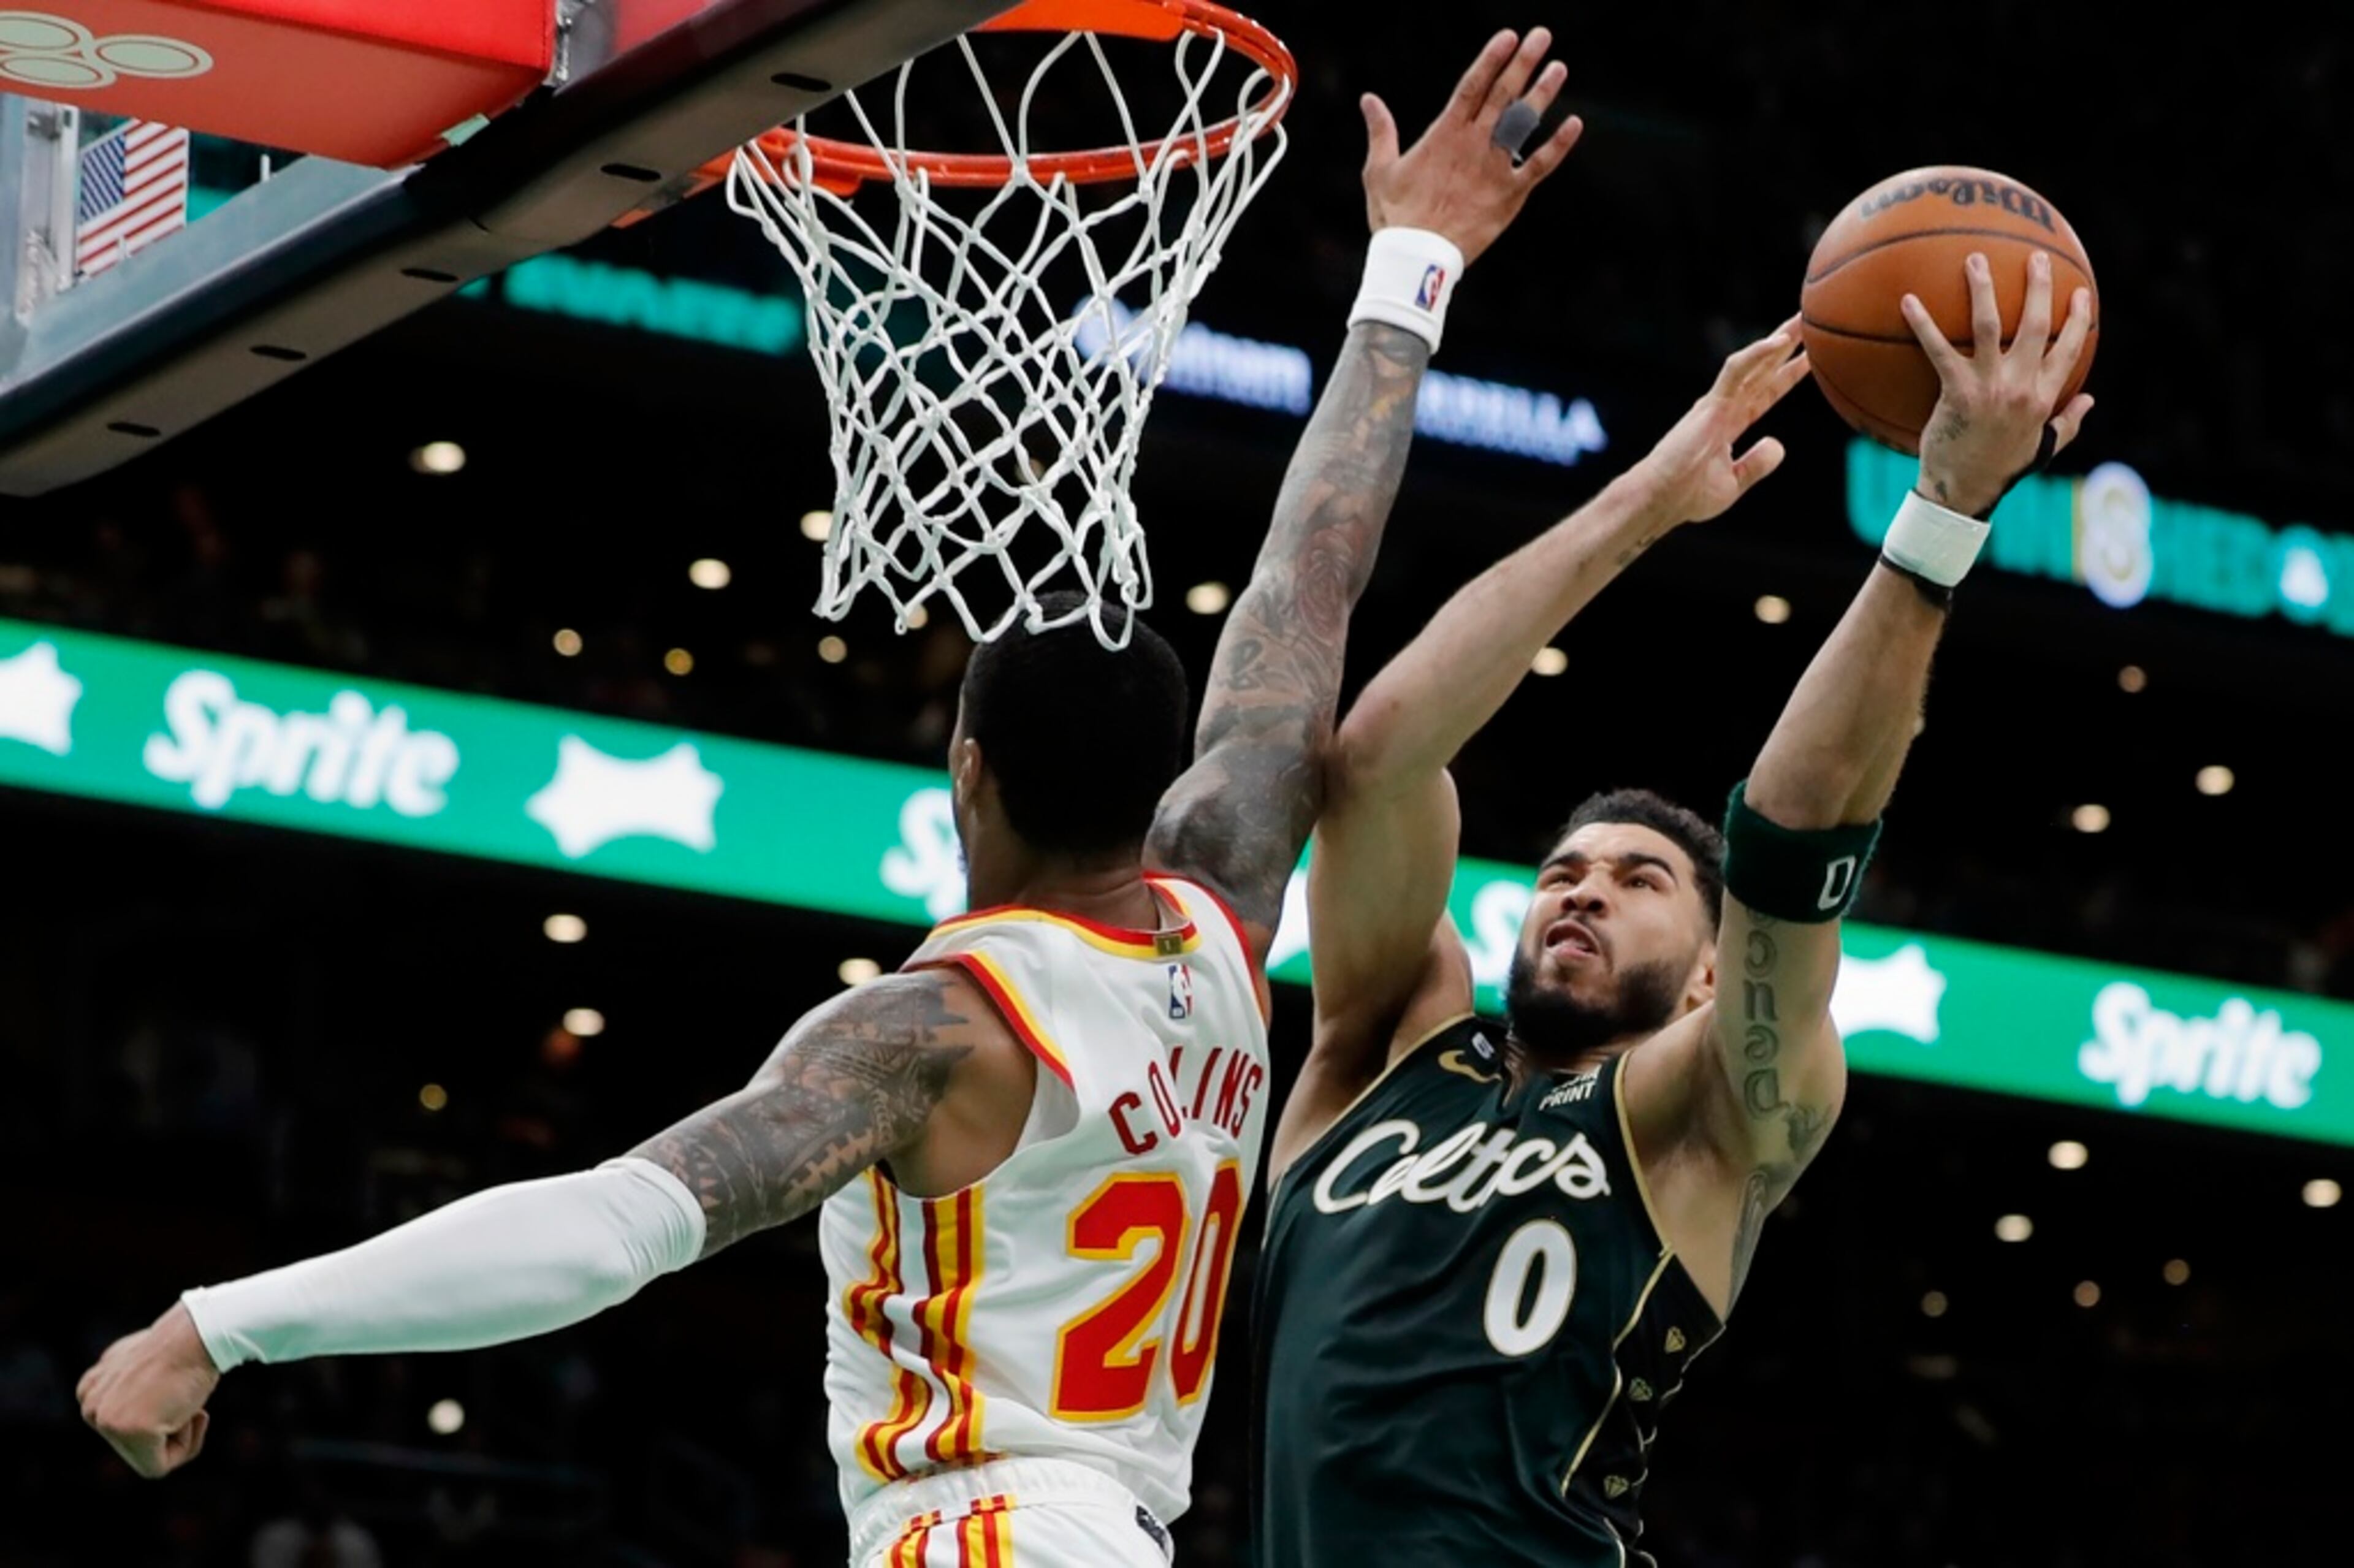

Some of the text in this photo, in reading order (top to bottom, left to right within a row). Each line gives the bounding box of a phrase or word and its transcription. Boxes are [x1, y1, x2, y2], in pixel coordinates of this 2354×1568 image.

[142, 668, 460, 818] Sprite
[1108, 1045, 1263, 1156] COINS
[2078, 981, 2322, 1110] Sprite
[1312, 1119, 1612, 1214] Celtcs
[1049, 1156, 1244, 1423] 20
[1484, 1218, 1578, 1357] 0
